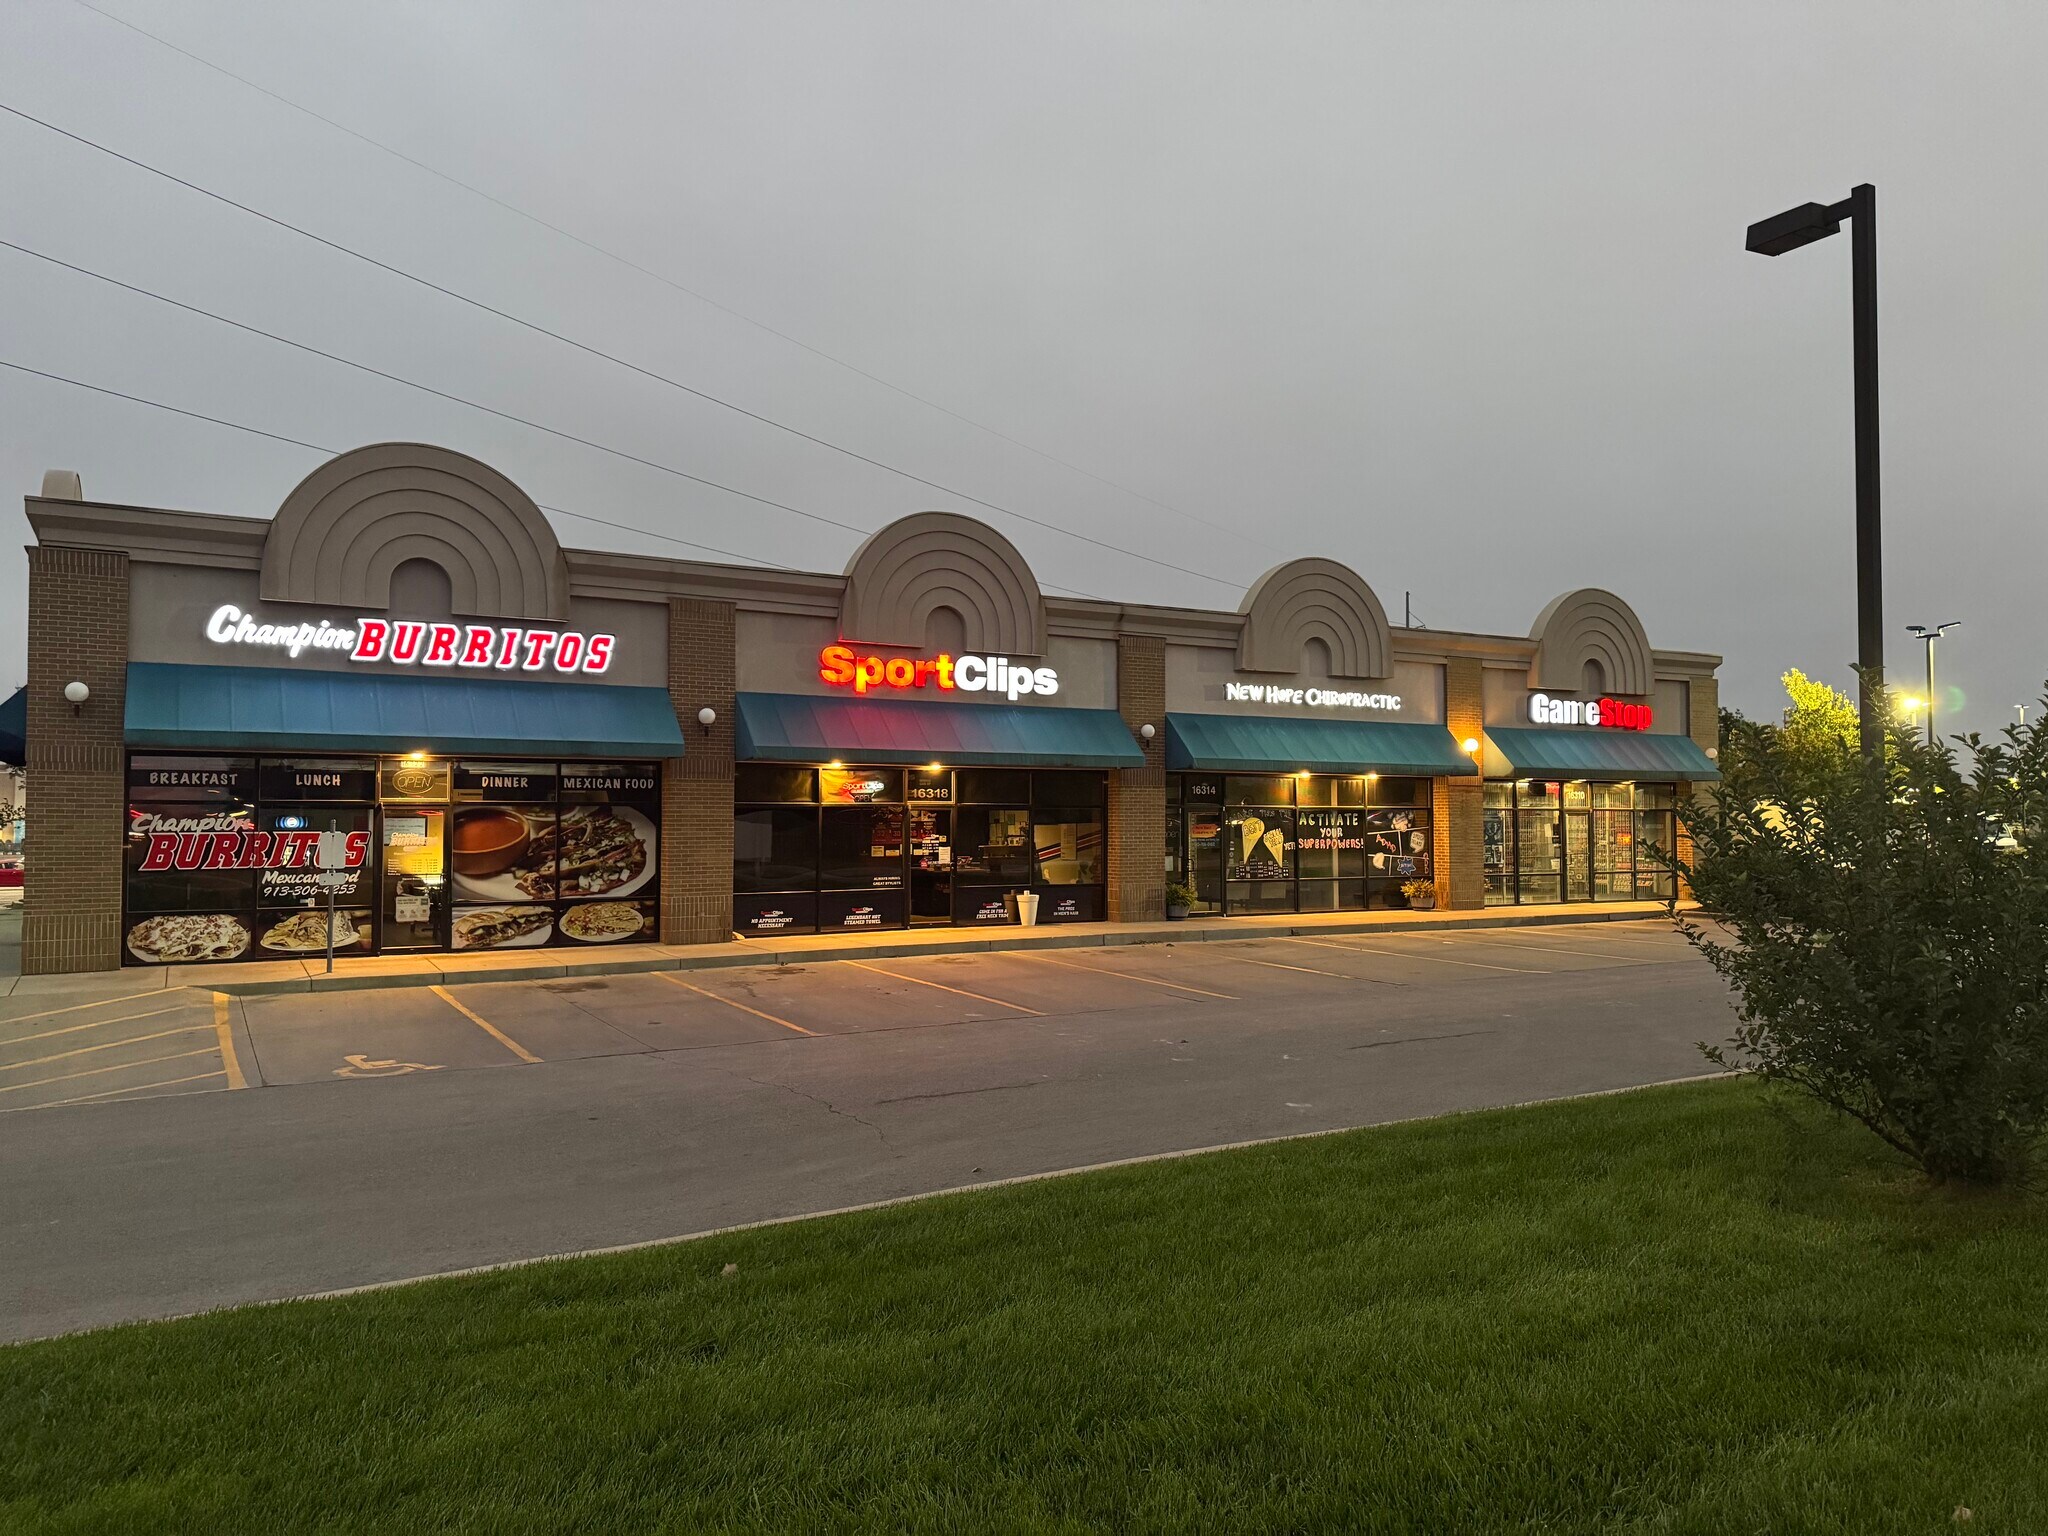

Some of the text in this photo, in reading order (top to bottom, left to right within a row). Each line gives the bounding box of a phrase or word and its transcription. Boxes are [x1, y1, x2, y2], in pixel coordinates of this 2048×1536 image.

[207, 604, 616, 674] Champion BURRITOS
[1529, 693, 1653, 731] GameStop
[149, 772, 238, 786] BREAKFAST
[296, 773, 341, 786] LUNCH
[397, 776, 431, 788] OPEN
[481, 776, 529, 788] DINNER
[563, 777, 655, 789] MEXICAN FOOD
[912, 788, 949, 799] 16318
[1191, 785, 1217, 795] 16314
[131, 812, 251, 835] Champion
[1299, 812, 1359, 826] ACTIVATE
[1320, 827, 1343, 838] YOUR
[1298, 838, 1364, 850] SUPERPOWERS!
[138, 831, 372, 871] BURRITS
[262, 870, 320, 885] Mexican
